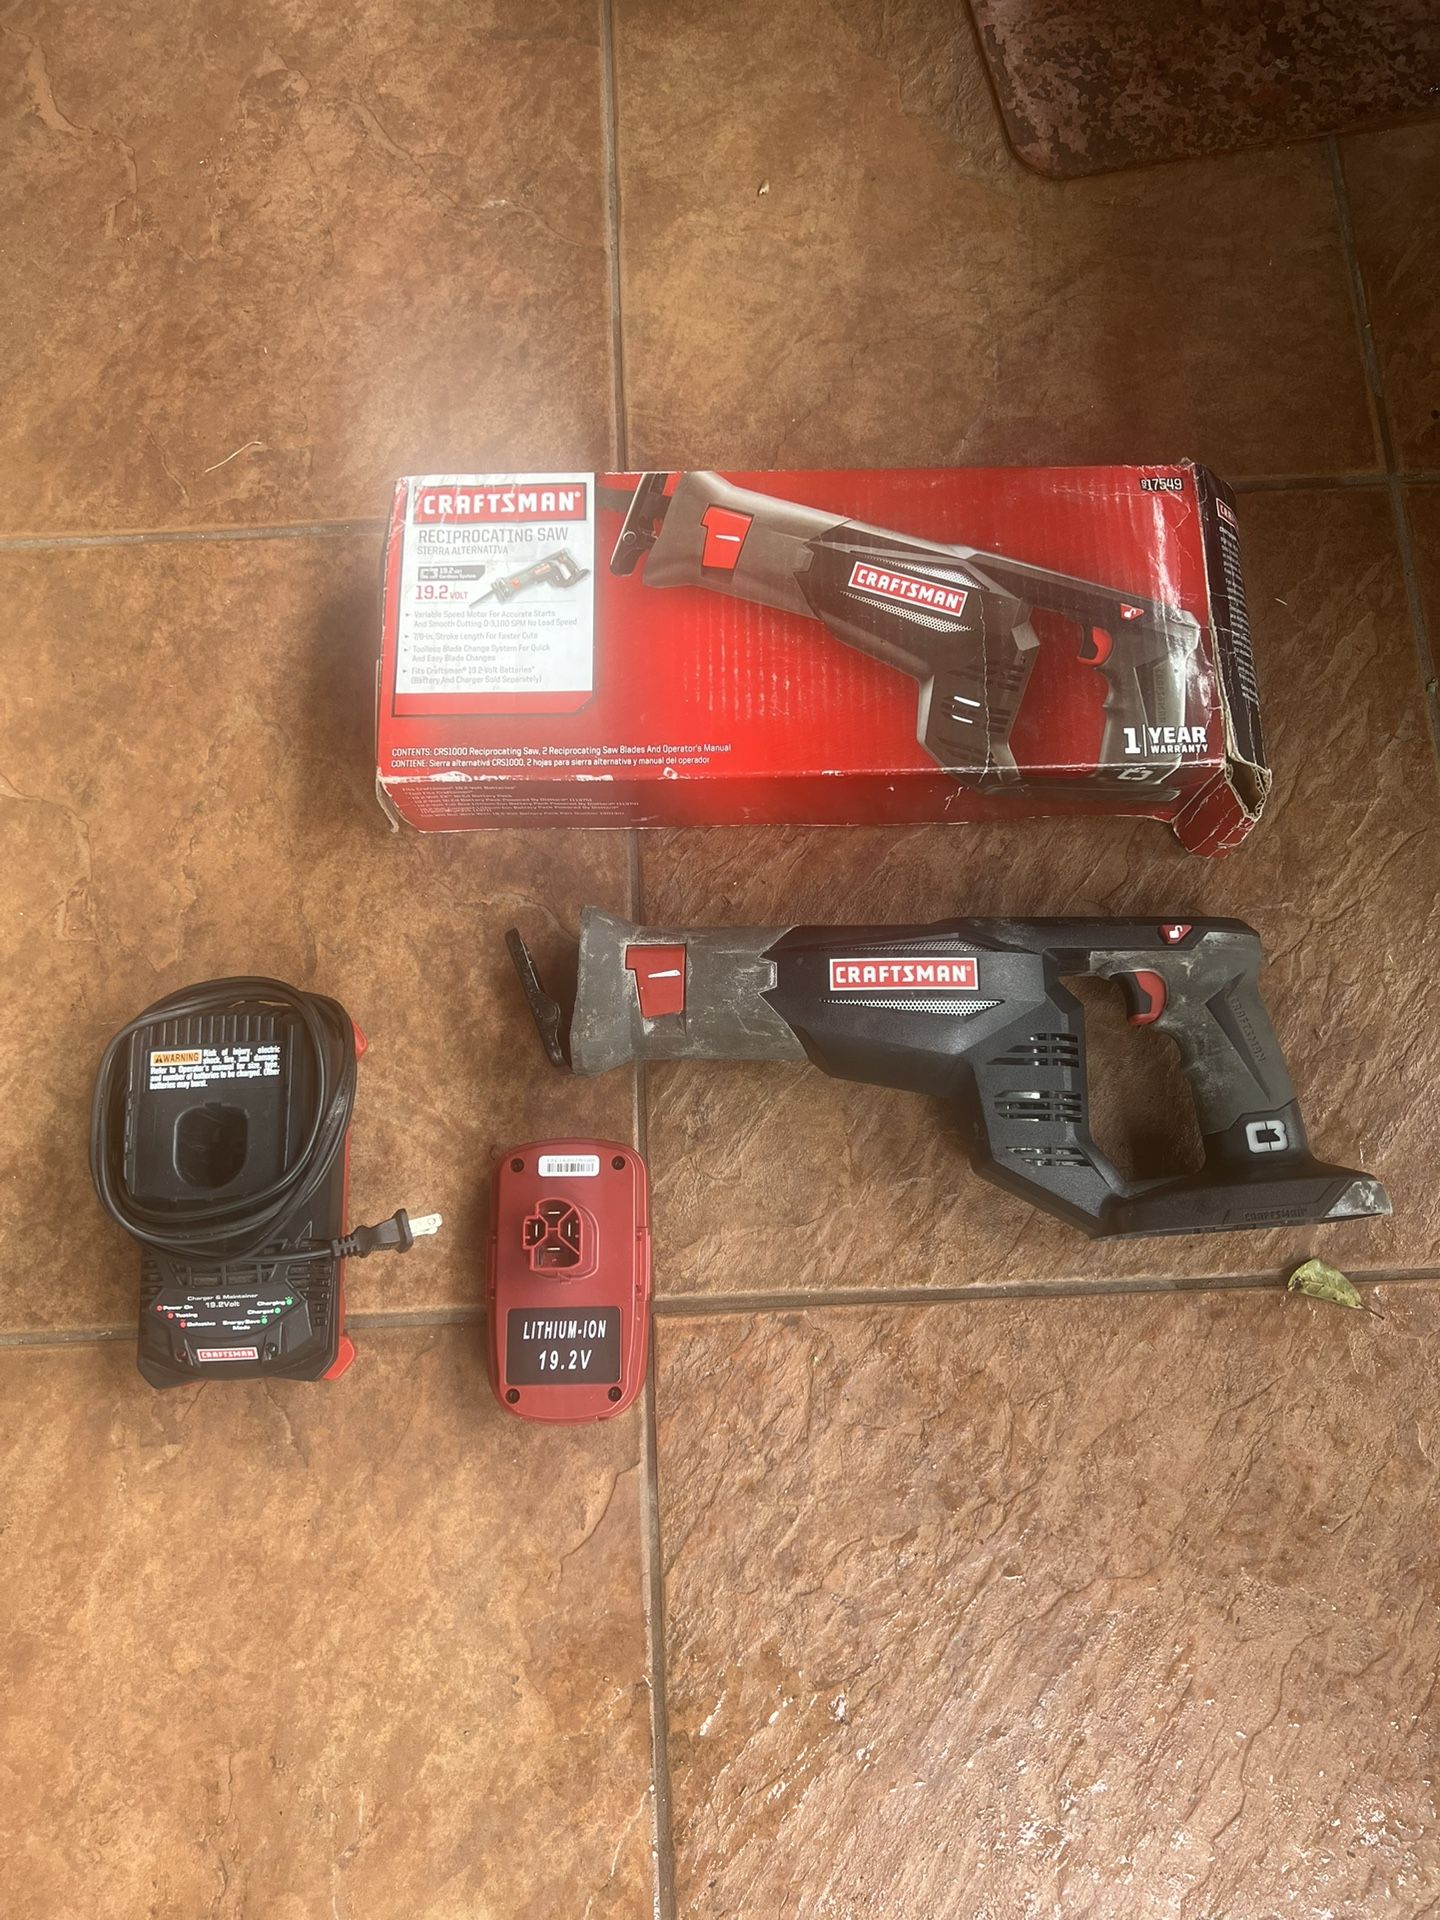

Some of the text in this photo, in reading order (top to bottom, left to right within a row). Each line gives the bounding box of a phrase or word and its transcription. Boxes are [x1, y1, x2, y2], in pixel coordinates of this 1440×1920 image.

[418, 527, 568, 544] RECIPROCATING SAW
[417, 544, 508, 556] SIERRA ALTERNATIVA
[415, 584, 468, 600] 19.2 VOLT
[414, 610, 442, 618] Variable
[443, 610, 464, 619] Speed
[467, 610, 487, 618] Motor
[501, 609, 532, 618] Accurate
[534, 609, 556, 617] Starts
[414, 620, 427, 628] And
[428, 619, 455, 628] Smooth
[456, 619, 482, 629] Cutting
[511, 619, 526, 627] SPM
[528, 619, 537, 627] No
[538, 618, 554, 626] Load
[556, 618, 578, 627] Speed
[436, 632, 459, 640] Stroke
[460, 632, 485, 641] Length
[522, 631, 538, 639] Cuts
[443, 644, 462, 653] Blade
[464, 644, 490, 654] Change
[491, 644, 517, 653] System
[518, 644, 529, 652] For
[530, 643, 550, 652] Quick
[412, 654, 496, 663] And Easy Blade Changes
[411, 667, 425, 675] Fits
[410, 675, 542, 685] (Battery And Charger Sold Separately)
[1123, 726, 1207, 754] 1 YEAR
[391, 747, 433, 756] CONTENTS:
[433, 747, 468, 756] CRS1000
[469, 747, 522, 757] Reciprocating
[542, 747, 548, 755] 2
[550, 746, 601, 756] Reciprocating
[602, 746, 619, 754] Saw
[619, 746, 645, 754] Blades
[646, 745, 660, 753] And
[662, 744, 702, 754] Operator's
[703, 744, 732, 752] Manual
[1150, 744, 1209, 754] WARRANTY
[391, 759, 428, 768] CONTIENE:
[429, 759, 451, 767] Sierra
[452, 759, 491, 767] alternativa
[532, 758, 553, 767] hojas
[553, 759, 570, 767] para
[571, 758, 592, 766] sierra
[593, 757, 632, 766] alternativa
[632, 759, 637, 767] y
[638, 757, 665, 765] manual
[666, 756, 677, 764] del
[678, 756, 711, 765] operador
[256, 1045, 281, 1054] electric
[163, 1052, 199, 1063] WARNING
[256, 1299, 286, 1307] Charging
[522, 1319, 607, 1341] LITHIUM-ION
[201, 1349, 254, 1359] CRAFTSMAN
[538, 1348, 593, 1371] 19.2V
